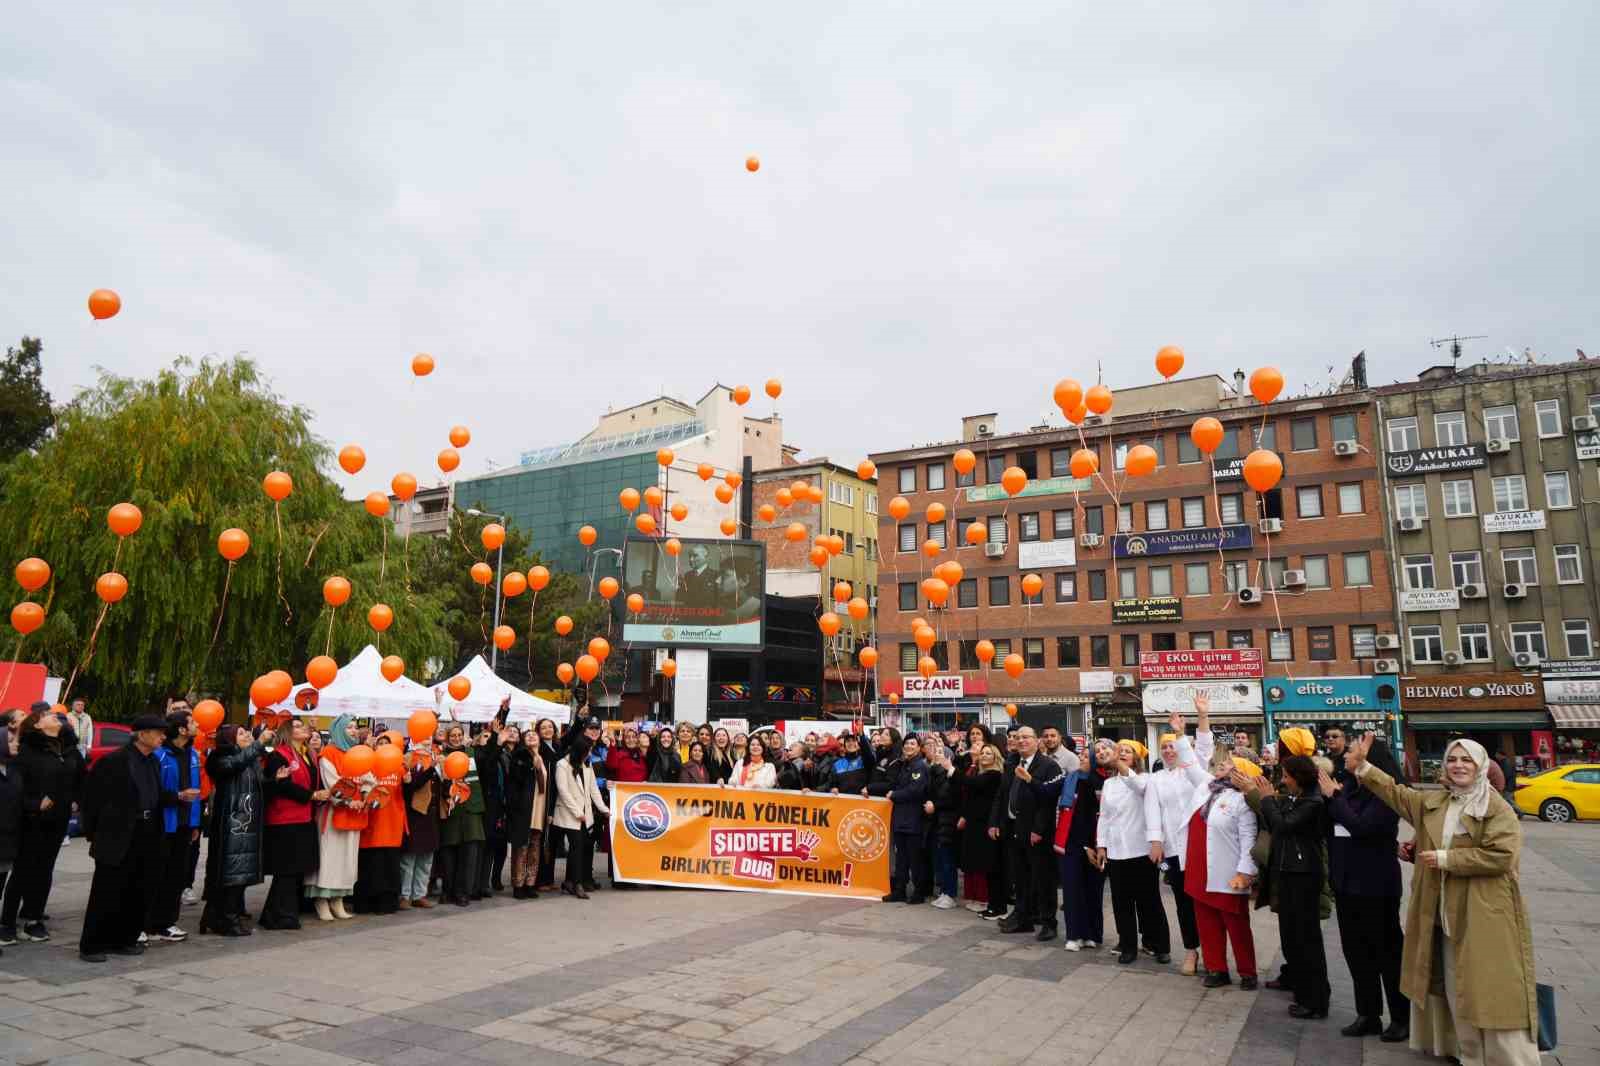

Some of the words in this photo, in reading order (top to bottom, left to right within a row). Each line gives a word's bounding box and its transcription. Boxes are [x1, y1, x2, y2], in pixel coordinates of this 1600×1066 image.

[1419, 446, 1476, 461] AVUKAT
[1494, 512, 1535, 521] AVUKAT
[1150, 533, 1198, 545] ANADOLU
[1166, 653, 1195, 663] EKOL
[906, 679, 960, 690] ECZANE
[1296, 683, 1334, 695] elite
[1405, 685, 1464, 698] HELVACI
[1486, 682, 1536, 697] YAKUB
[1325, 695, 1366, 706] optik
[675, 798, 745, 820] KADINA
[753, 802, 831, 828] YÖNELİK
[713, 831, 793, 855] ŞİDDETE
[660, 855, 731, 876] BİRLİKTE
[740, 857, 774, 879] DUR
